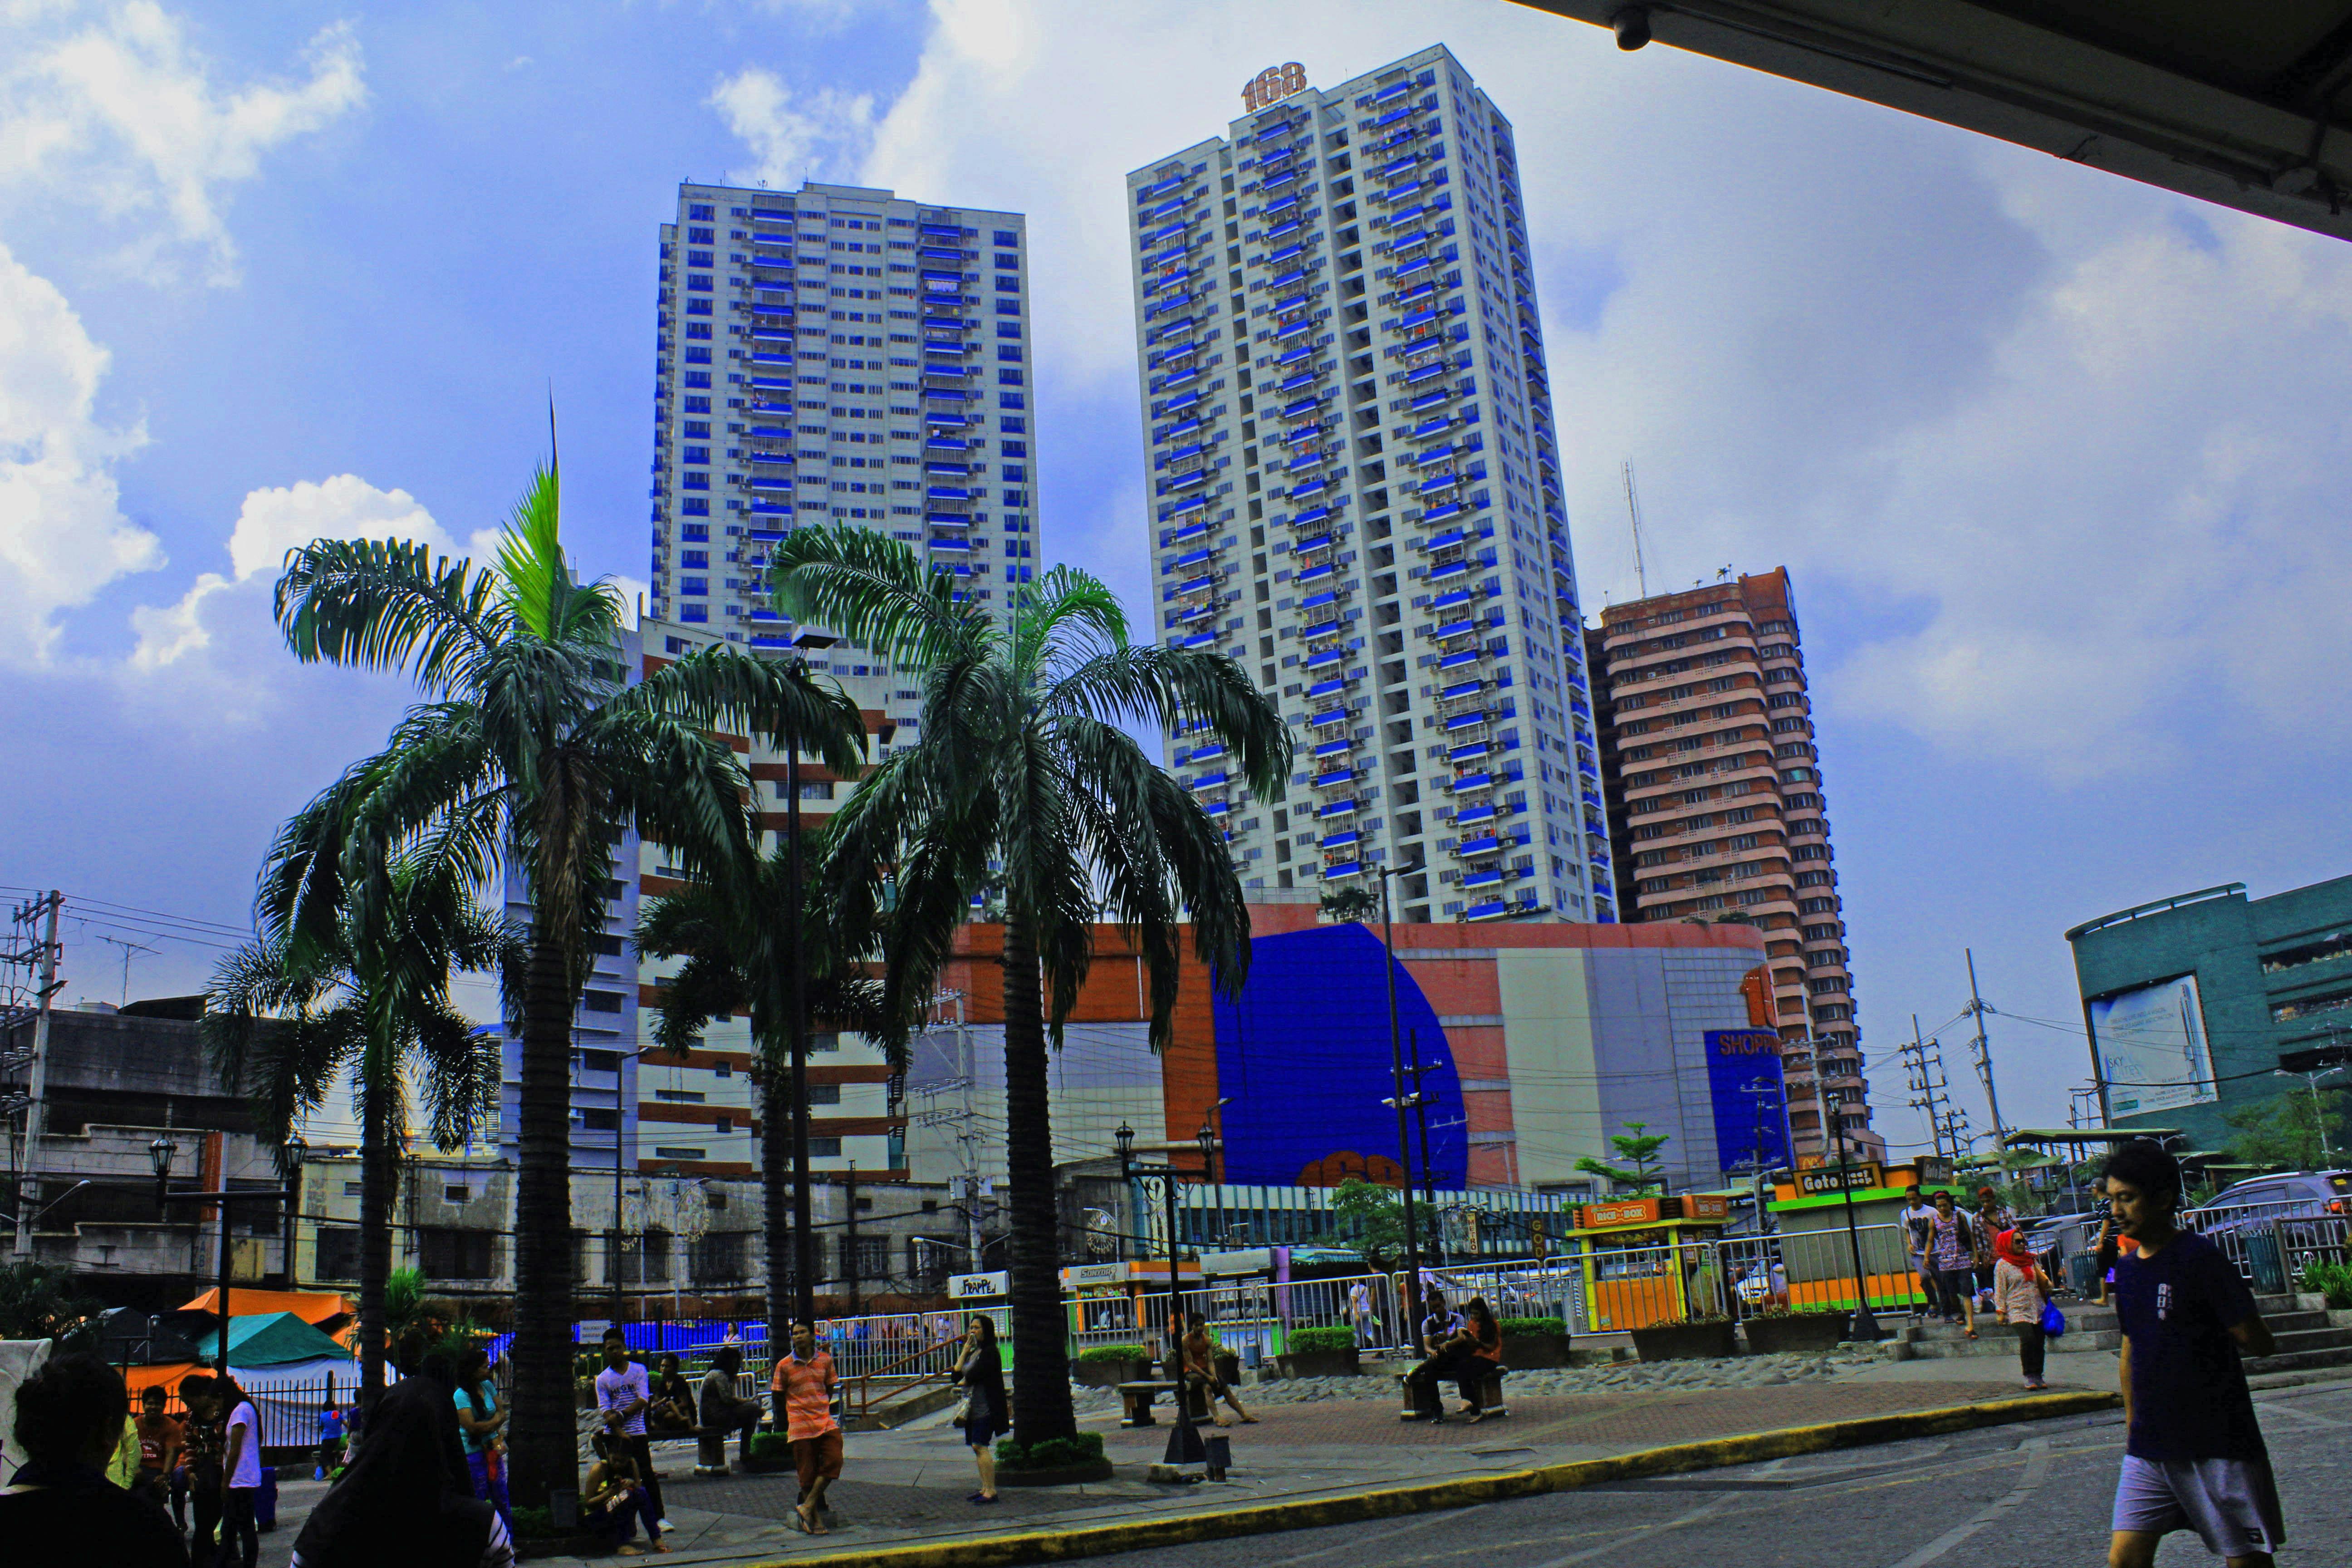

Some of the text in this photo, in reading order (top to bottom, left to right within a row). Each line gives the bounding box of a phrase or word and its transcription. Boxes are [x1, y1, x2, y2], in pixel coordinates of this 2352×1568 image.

[1241, 62, 1307, 113] 168
[2109, 1056, 2123, 1068] SKY
[1803, 1174, 1838, 1191] Goto
[1597, 1211, 1617, 1221] RICE
[1623, 1208, 1644, 1218] BOX
